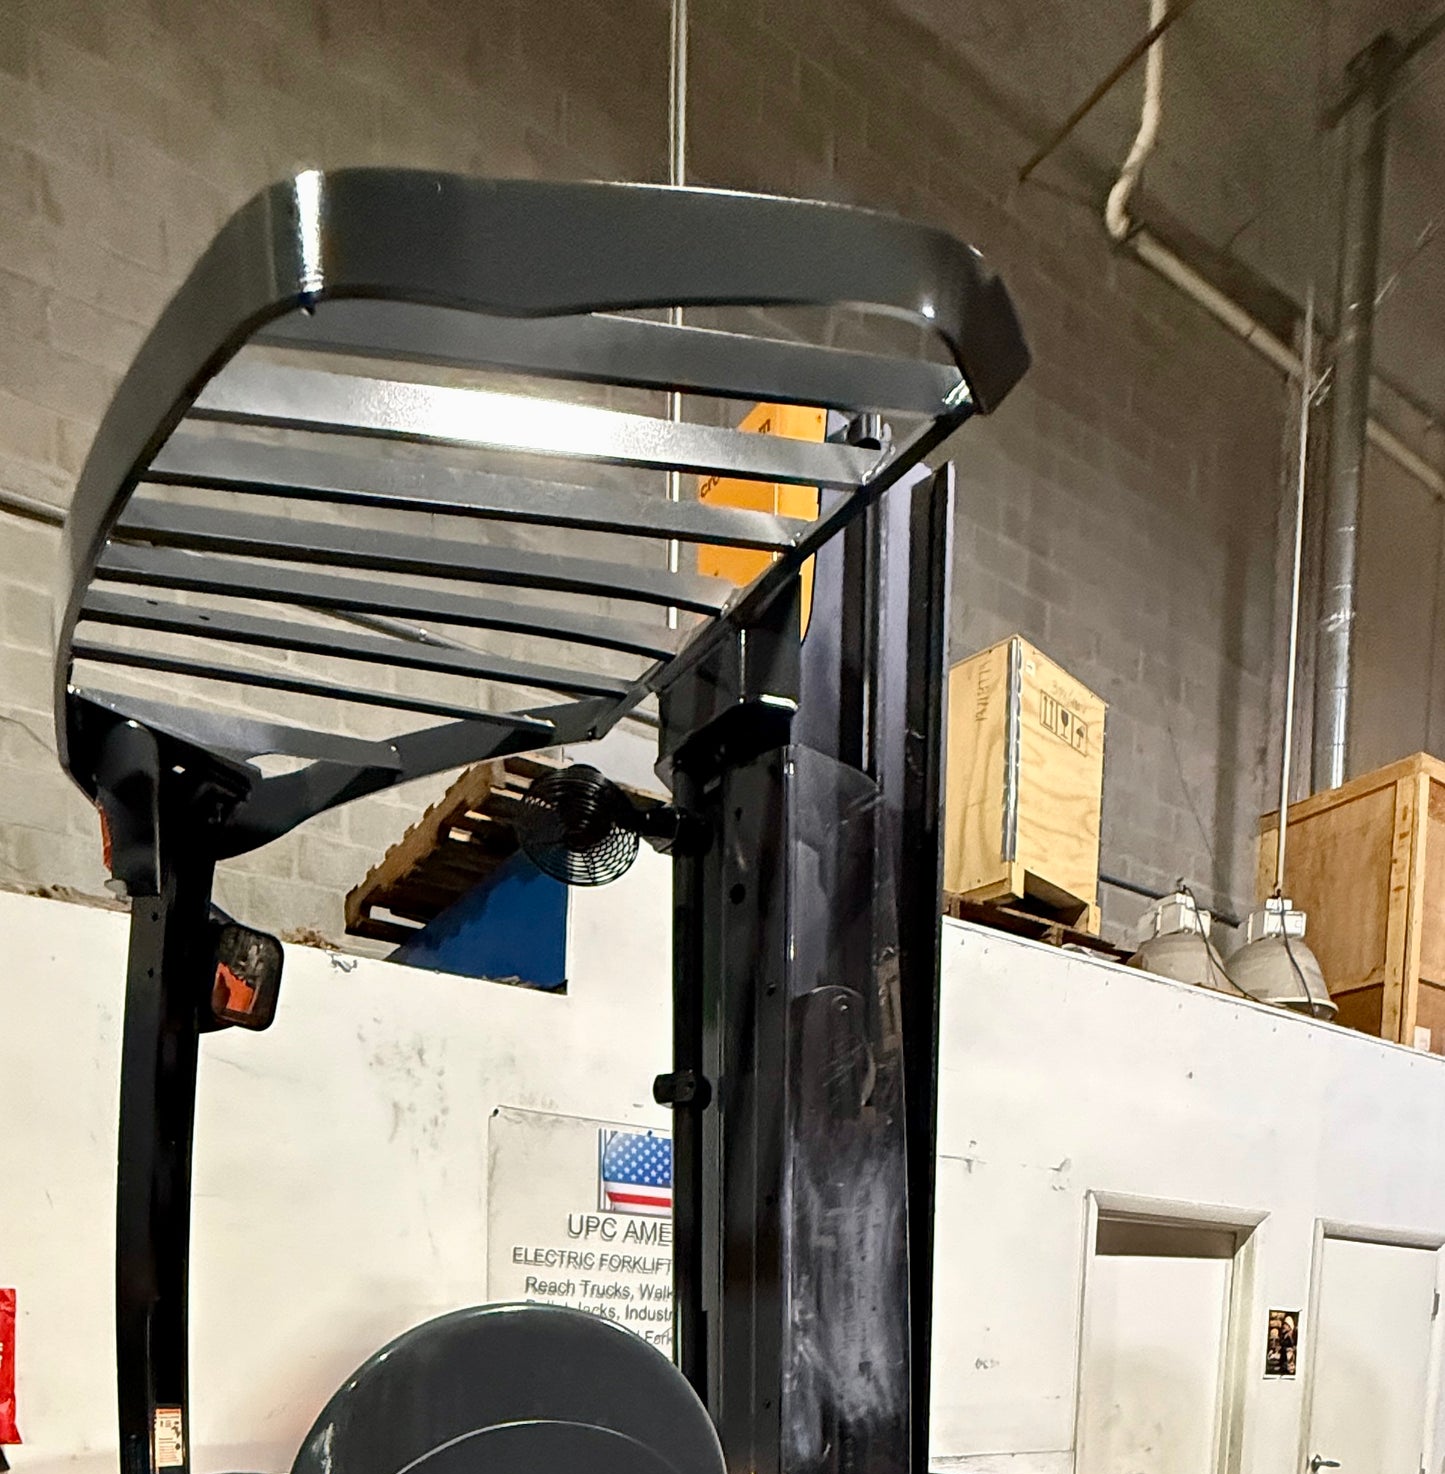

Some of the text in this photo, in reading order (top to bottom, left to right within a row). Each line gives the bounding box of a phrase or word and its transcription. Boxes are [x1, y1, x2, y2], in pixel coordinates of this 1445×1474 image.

[567, 1213, 618, 1241] UPC
[512, 1246, 672, 1275] ELECTRIC FORKLIFT
[524, 1276, 576, 1297] Reach
[578, 1279, 634, 1301] Trucks,
